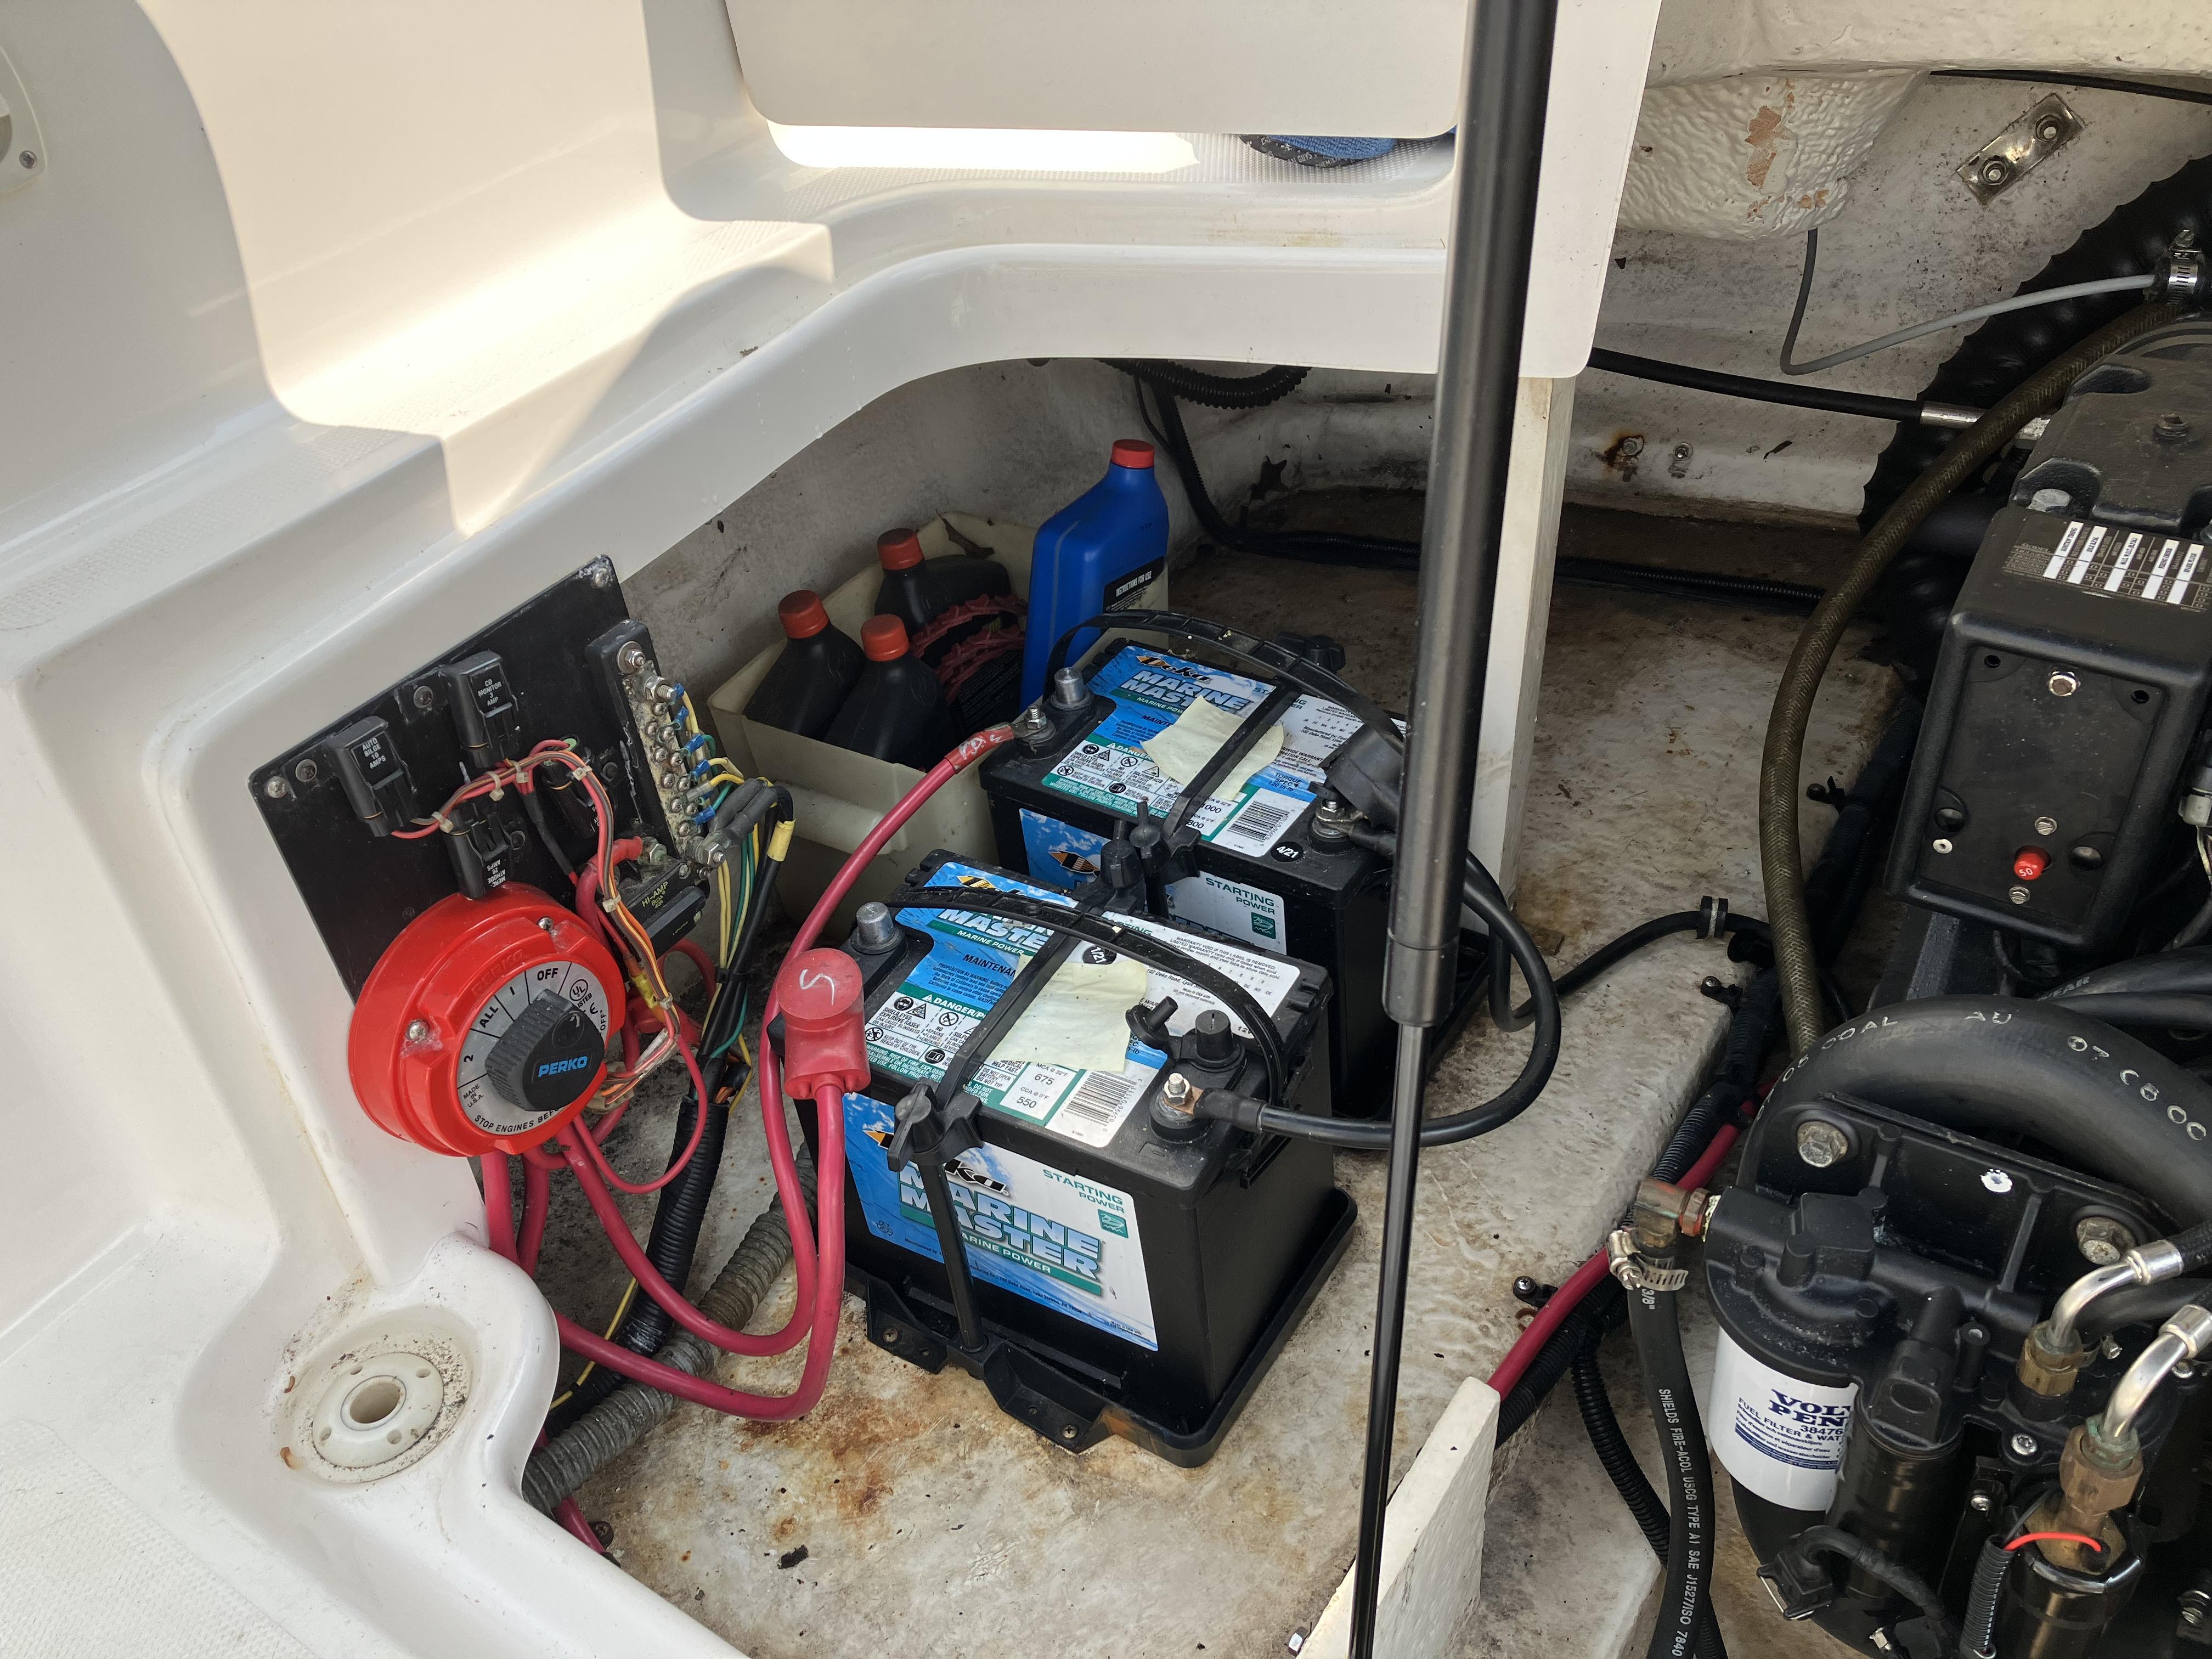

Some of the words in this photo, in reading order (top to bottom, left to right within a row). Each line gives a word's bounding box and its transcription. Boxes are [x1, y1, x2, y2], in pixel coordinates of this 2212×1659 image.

[477, 681, 501, 697] MONITOR
[1133, 670, 1252, 710] MARINE
[487, 697, 499, 706] AMP
[1136, 697, 1167, 709] MARINE
[1141, 715, 1173, 727] MAINTE
[362, 737, 377, 751] AUTO
[364, 743, 381, 757] BILGE
[1116, 745, 1153, 761] DANGER
[1299, 752, 1324, 761] WARRANT
[369, 755, 386, 769] AMPS
[1276, 773, 1301, 783] TORQUE
[1201, 803, 1222, 813] 1000
[1276, 846, 1299, 858] 4/21
[487, 859, 500, 871] AMPS
[2019, 866, 2033, 877] 50
[1206, 877, 1275, 906] STARTING
[1236, 896, 1275, 915] POWER
[939, 909, 1050, 950] MASTE
[957, 930, 991, 944] MARINE
[992, 941, 1024, 955] POWER
[1170, 939, 1188, 947] LIMITED
[1188, 944, 1215, 955] WARRANTY
[1176, 937, 1201, 947] WARRANTY
[1251, 960, 1276, 969] REMOVED.
[939, 963, 964, 974] PROPOSITION
[963, 955, 1016, 977] MAINTENAN
[537, 968, 558, 981] OFF
[955, 979, 973, 987] California
[577, 992, 592, 1008] ISTED
[933, 997, 986, 1018] DANGER/P
[479, 1005, 499, 1029] ALL
[883, 1007, 899, 1015] SHIELD
[879, 1012, 905, 1024] EXPLOSIVE
[905, 1020, 921, 1029] GASES
[879, 1022, 894, 1030] INJURY.
[898, 1023, 919, 1034] BLINDNESS
[900, 1045, 920, 1057] CHILDREN.
[538, 1055, 588, 1077] PERKO
[889, 1064, 908, 1074] FOLLOW
[921, 1064, 945, 1077] EXPLOSIO
[992, 1061, 1006, 1069] HELP
[1006, 1065, 1018, 1074] FAST.
[1035, 1062, 1049, 1072] MCA
[1055, 1069, 1068, 1077] 32°F
[1034, 1073, 1054, 1085] 675
[463, 1084, 480, 1099] MADE
[1020, 1086, 1033, 1095] CCA
[467, 1094, 484, 1108] U.S.A.
[1016, 1096, 1037, 1109] 550
[475, 1115, 494, 1128] STOP
[496, 1120, 534, 1132] ENGINES
[538, 1108, 560, 1123] BEF
[1043, 1169, 1124, 1205] STARTING
[1079, 1191, 1125, 1214] POWER
[900, 1166, 1099, 1260] MARINE
[900, 1183, 1098, 1279] MASTER
[961, 1233, 1000, 1252] ARINE
[1003, 1249, 1051, 1273] POWER
[1658, 1389, 1679, 1424] SHIELDS
[1771, 1389, 1851, 1416] VOL
[1739, 1397, 1761, 1420] FUEL
[1764, 1417, 1801, 1437] FILTER
[1769, 1400, 1848, 1426] PEN
[1801, 1425, 1843, 1435] 38476
[1669, 1427, 1692, 1473] FIRE-ACOL
[1682, 1476, 1697, 1501] USCG
[1687, 1505, 1701, 1529] TYPE
[1688, 1550, 1700, 1570] SAE
[1680, 1573, 1698, 1625] J1527/ISO
[1671, 1630, 1689, 1657] 7840
